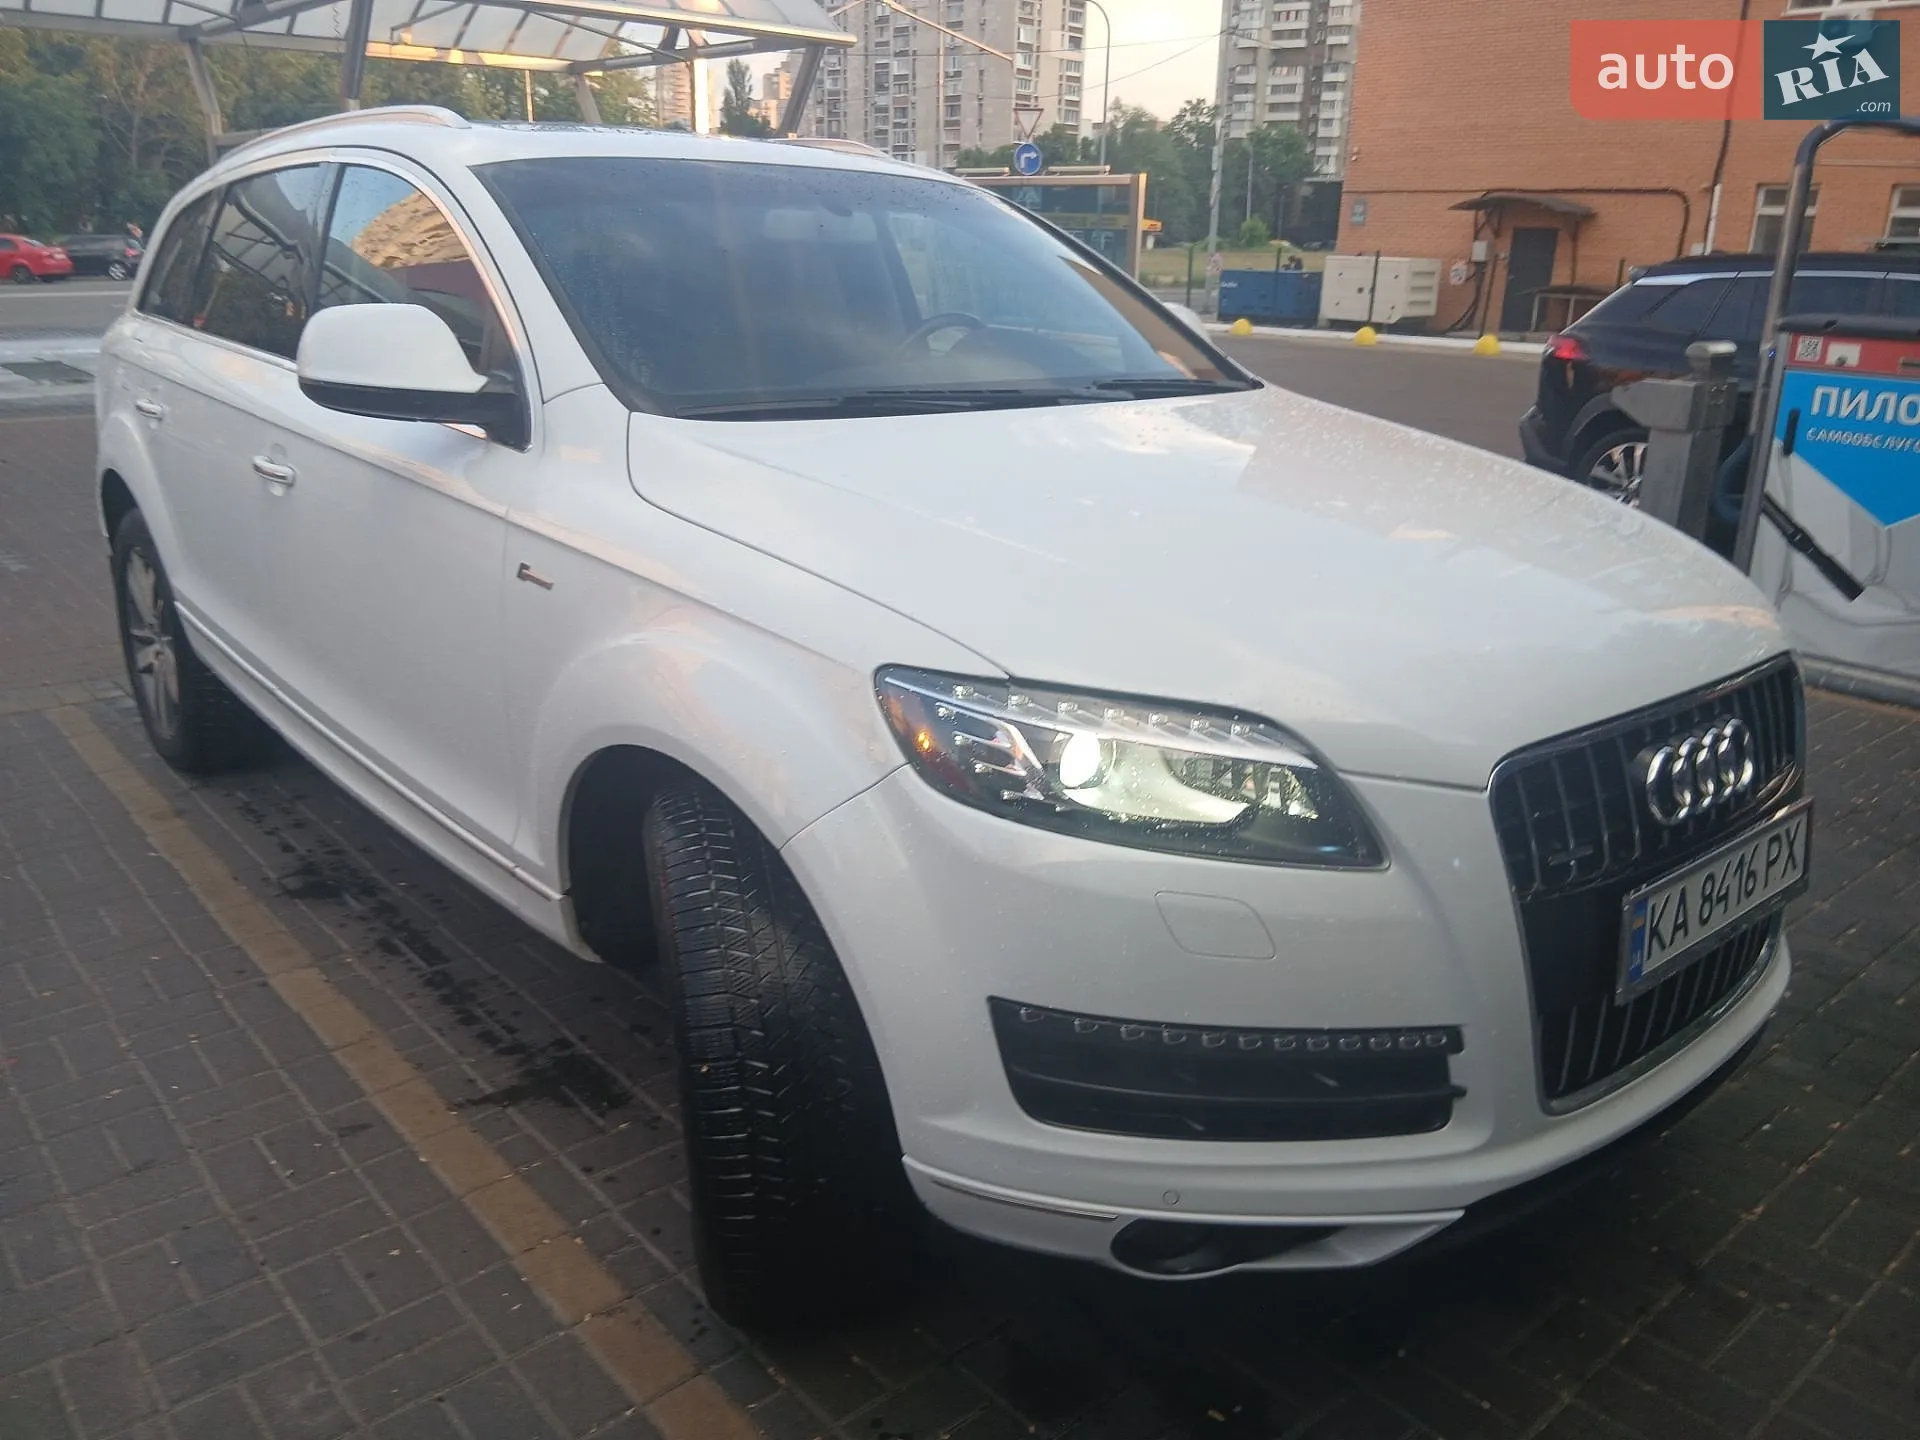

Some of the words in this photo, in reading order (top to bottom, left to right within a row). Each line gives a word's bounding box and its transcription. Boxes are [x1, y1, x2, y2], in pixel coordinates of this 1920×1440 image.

[1811, 386, 1920, 425] ПИЛО
[1647, 887, 1689, 959] KA
[1699, 844, 1757, 926] 8416
[1764, 822, 1801, 888] PX
